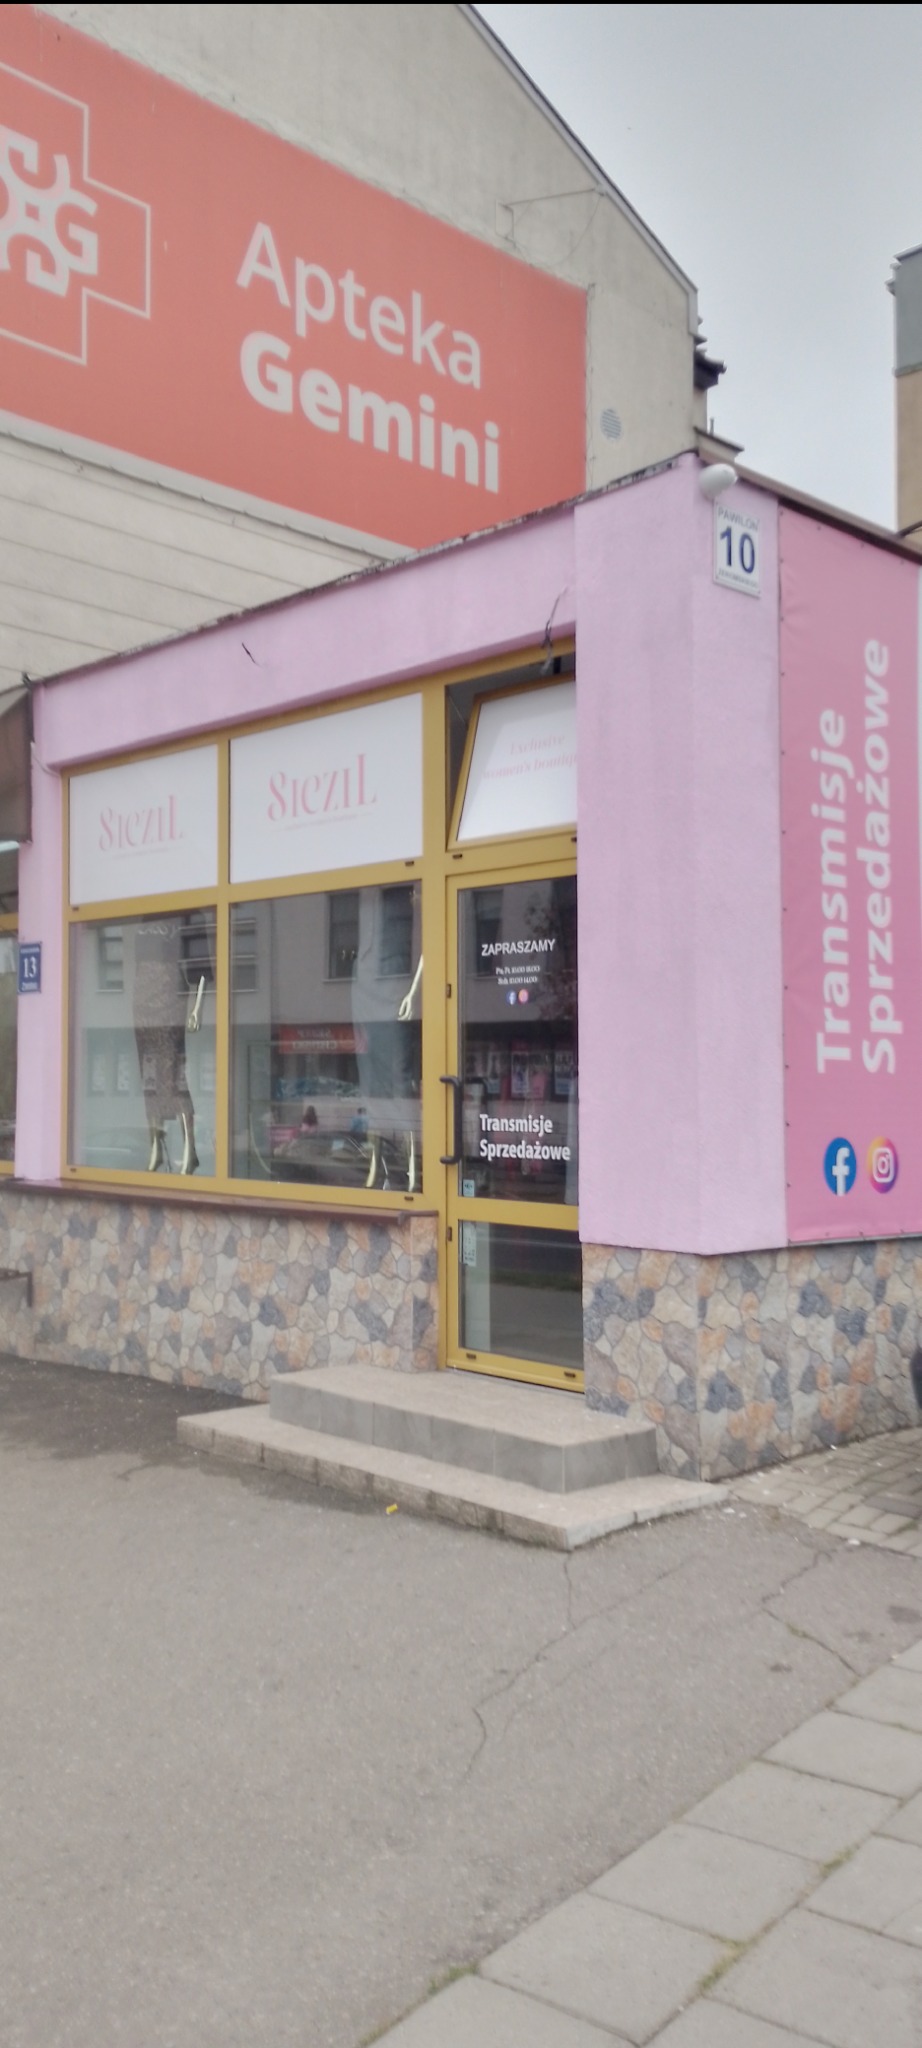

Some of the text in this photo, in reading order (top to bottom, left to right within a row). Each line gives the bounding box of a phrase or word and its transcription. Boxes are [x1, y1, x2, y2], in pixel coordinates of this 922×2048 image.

[236, 222, 482, 390] Apteka
[240, 331, 500, 494] Gemini
[720, 525, 755, 574] 10
[855, 638, 904, 1075] Sprzedażowe
[810, 708, 855, 1075] Transmisje
[24, 956, 37, 978] 13
[481, 938, 555, 956] ZAPRASZAMY
[479, 1113, 553, 1137] Transmisje
[479, 1138, 571, 1161] Sprzedażowe
